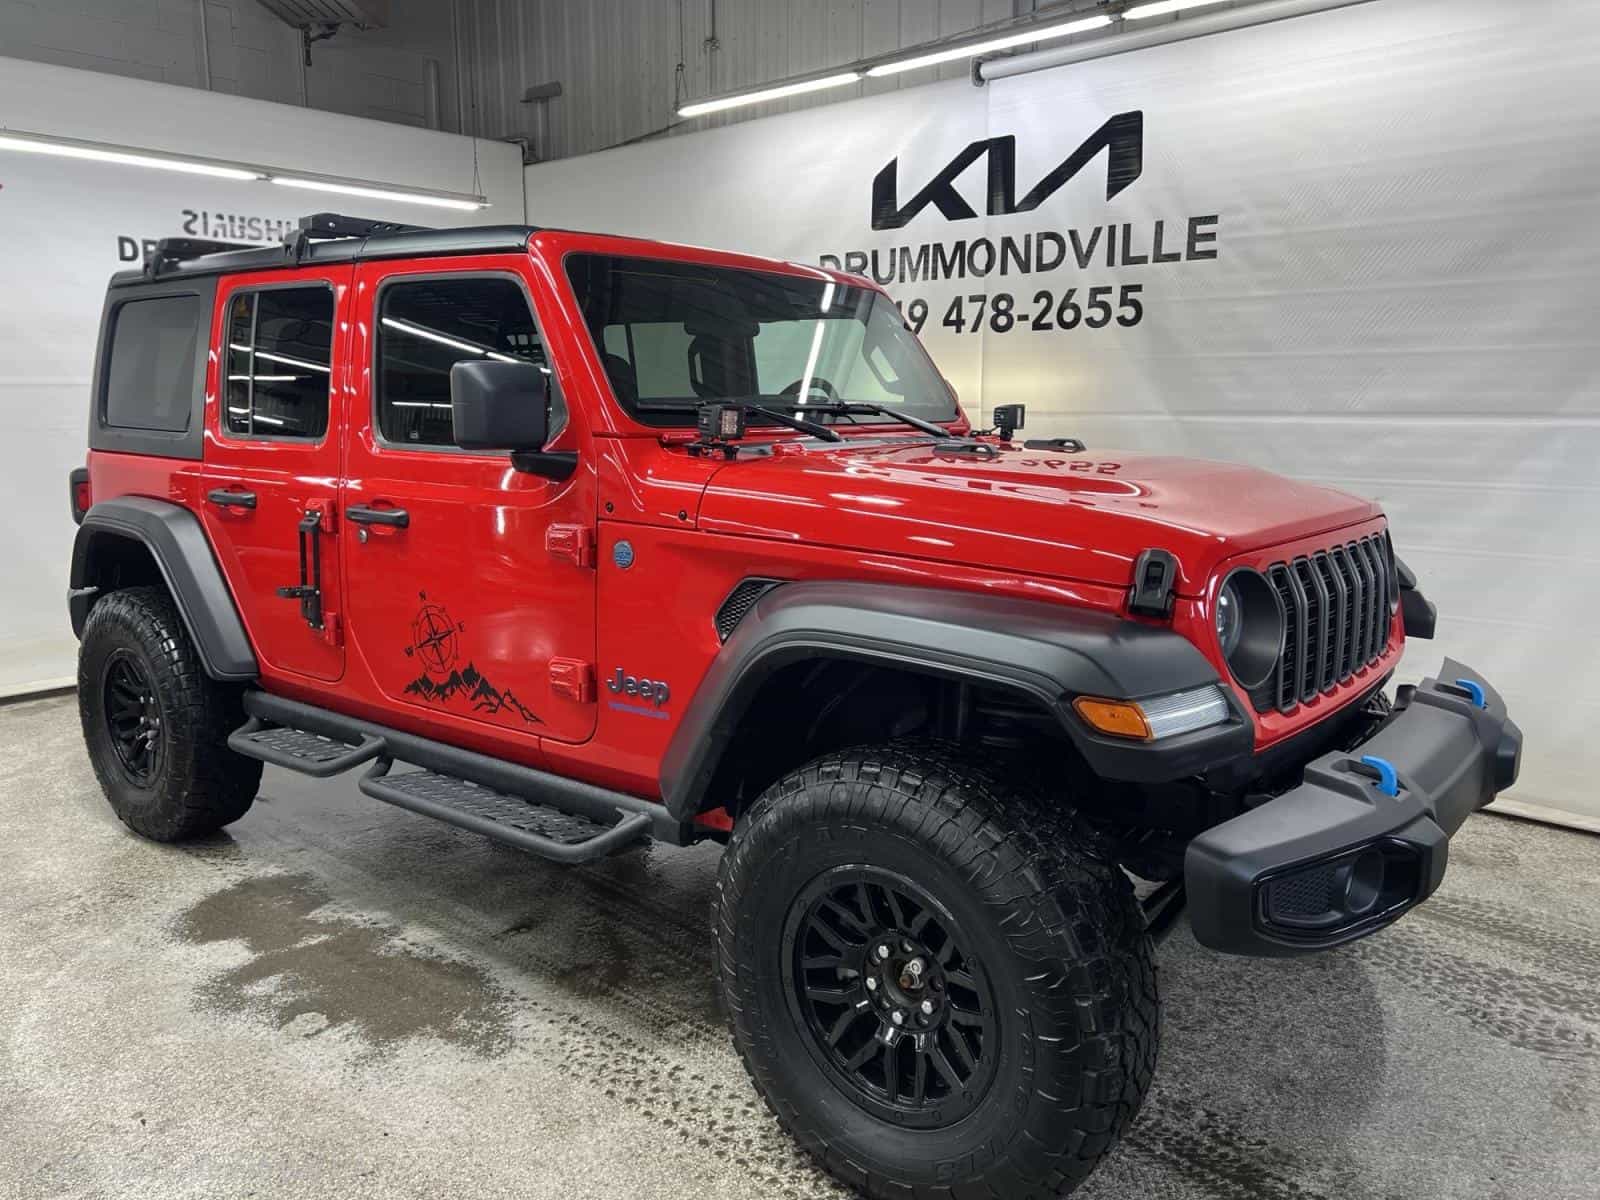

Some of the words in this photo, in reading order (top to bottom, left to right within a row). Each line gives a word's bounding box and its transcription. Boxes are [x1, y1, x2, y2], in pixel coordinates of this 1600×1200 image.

[871, 110, 1143, 231] KIA
[943, 284, 1144, 334] 478-2655
[606, 667, 670, 706] Jeep
